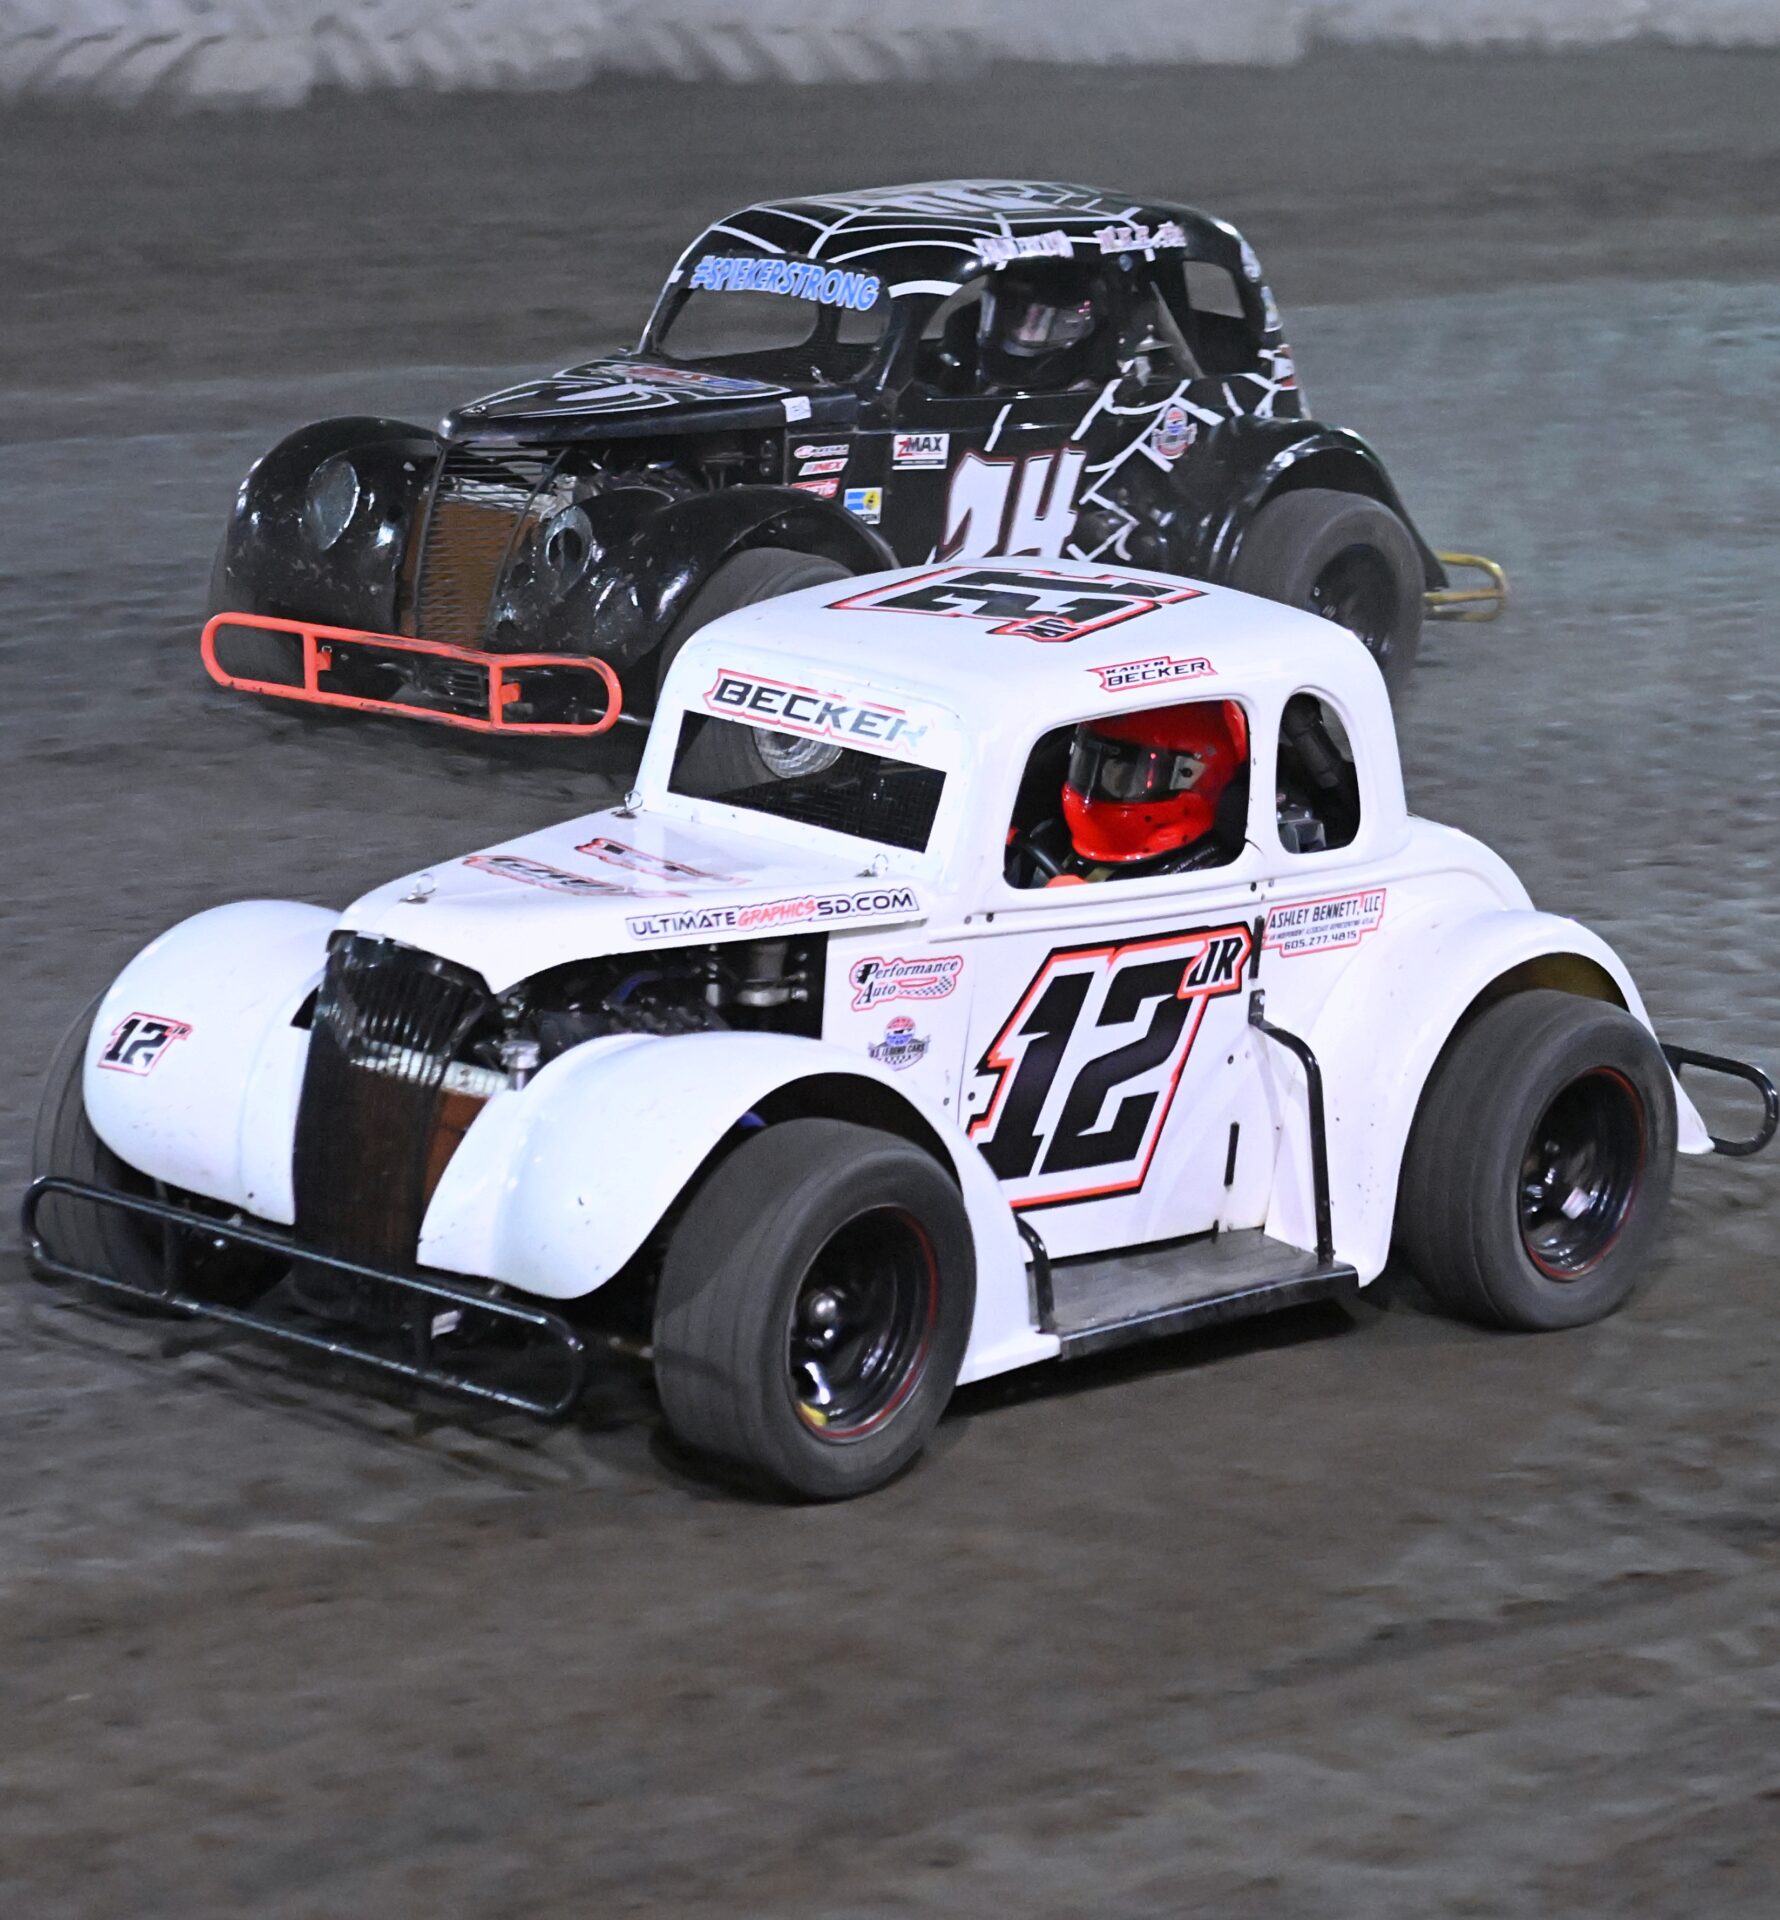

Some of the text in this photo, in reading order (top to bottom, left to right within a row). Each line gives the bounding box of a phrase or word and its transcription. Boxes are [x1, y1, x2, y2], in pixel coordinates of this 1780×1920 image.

[689, 255, 880, 311] #SPIEKERSTRONG
[1107, 661, 1206, 687] BECKER
[1268, 907, 1310, 930] ASHLEY
[1311, 899, 1360, 923] BENNETT,
[1363, 895, 1381, 914] LLC
[1284, 929, 1358, 951] 605.277.4815
[856, 960, 959, 985] Performance
[1186, 936, 1243, 988] JR
[856, 980, 897, 1006] Auto
[976, 956, 1197, 1182] 12
